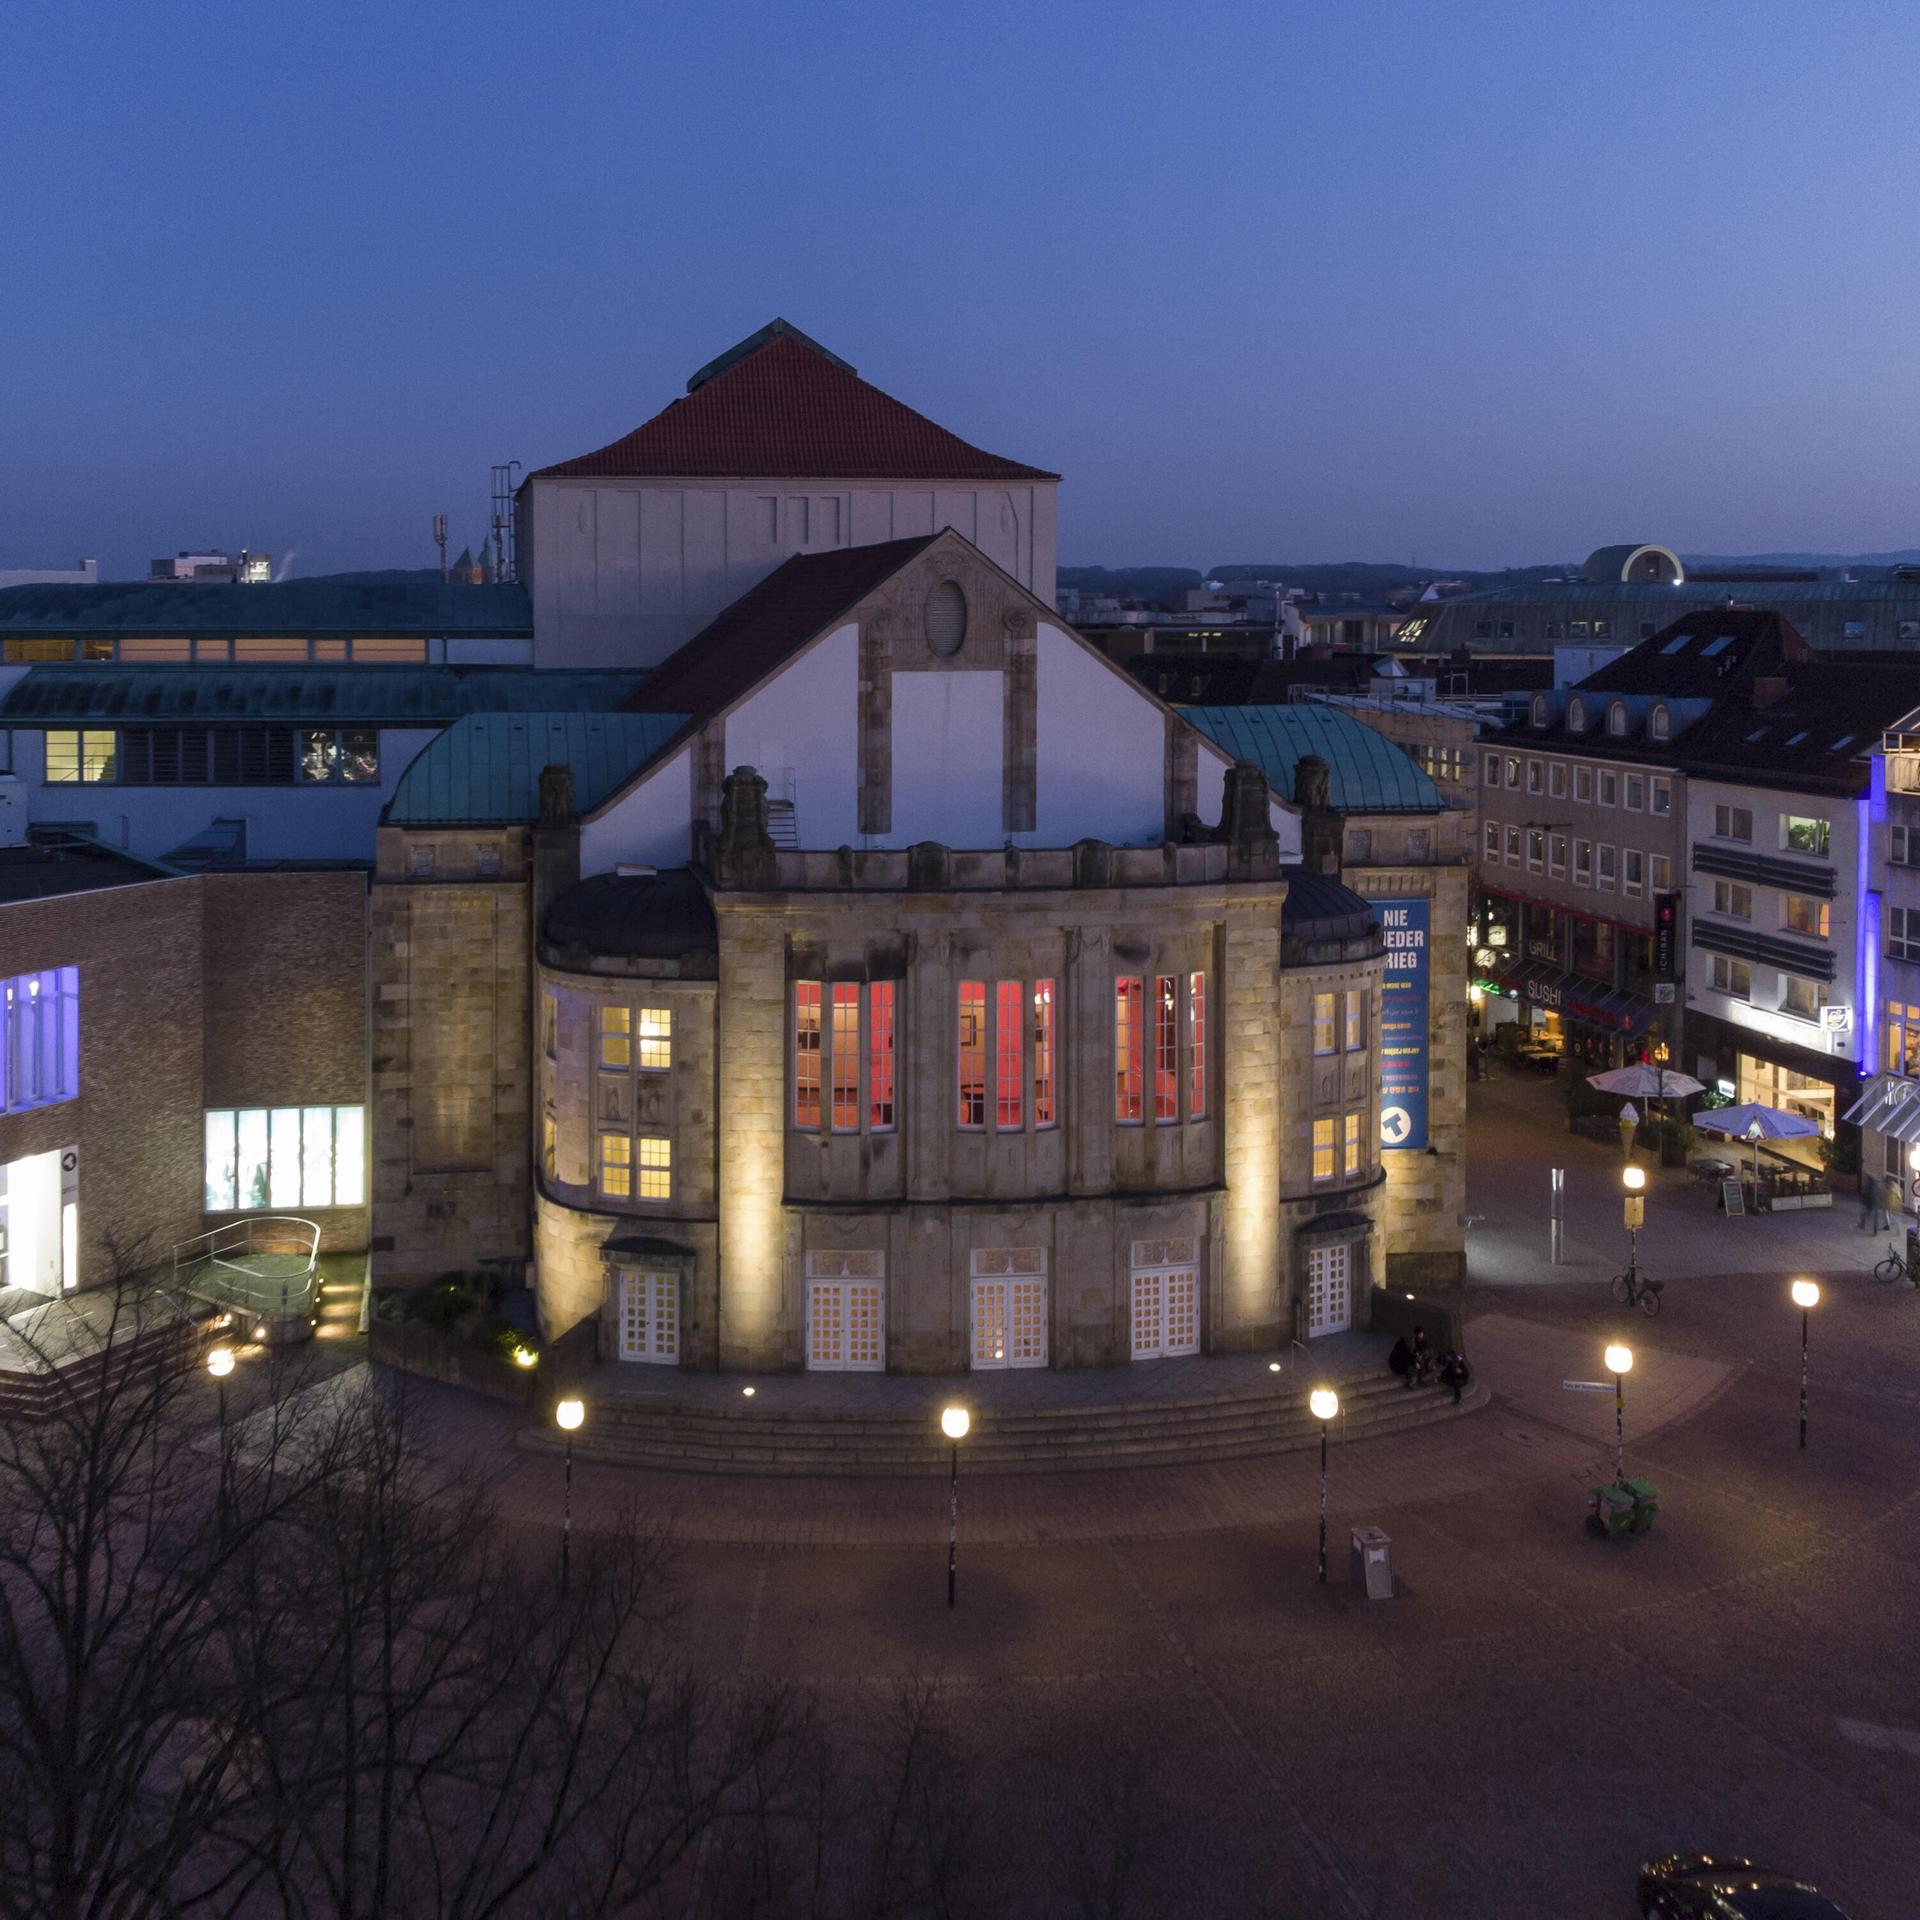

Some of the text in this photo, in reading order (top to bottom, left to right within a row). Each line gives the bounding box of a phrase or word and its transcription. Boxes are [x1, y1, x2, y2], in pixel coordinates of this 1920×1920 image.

[1384, 910, 1408, 926] NIE
[1383, 930, 1423, 948] IEDER
[1386, 952, 1417, 969] RIEG
[1529, 942, 1558, 962] GRILL
[1528, 979, 1561, 1007] SUSHI
